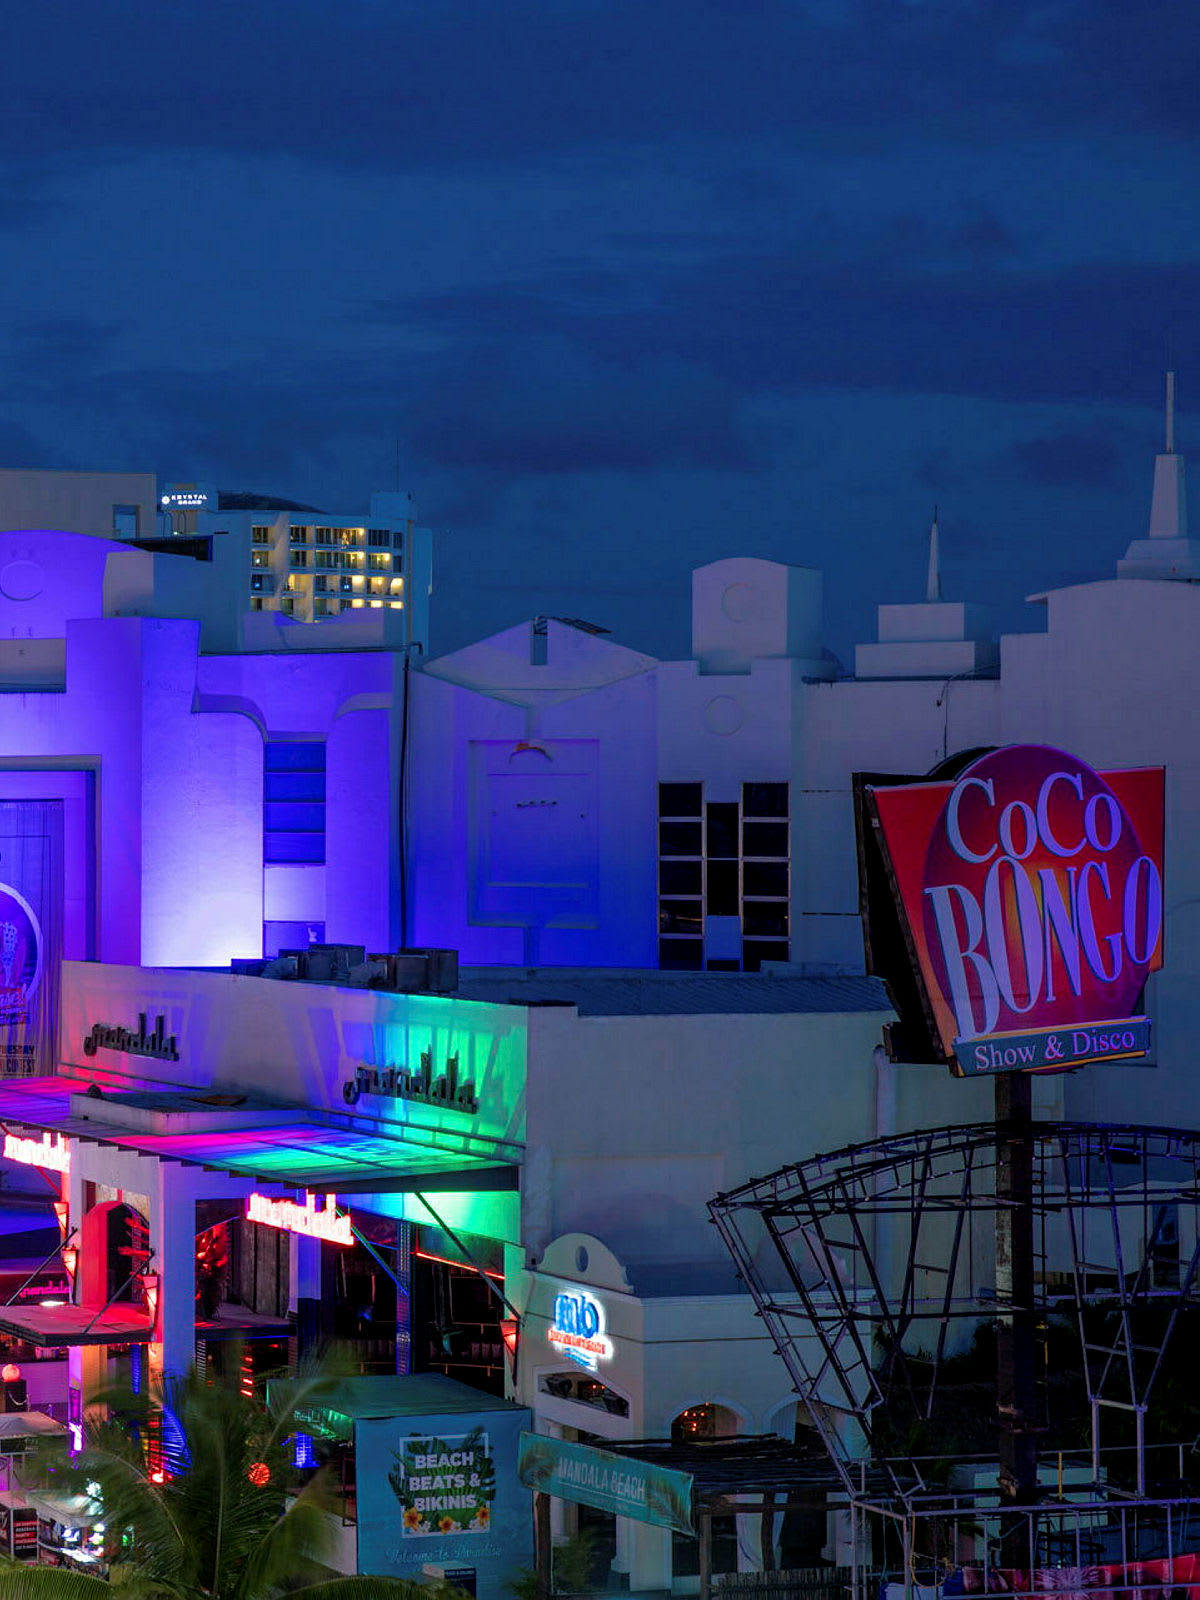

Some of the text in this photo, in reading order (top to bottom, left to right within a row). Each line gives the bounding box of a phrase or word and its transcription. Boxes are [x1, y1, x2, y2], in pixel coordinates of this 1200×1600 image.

[922, 855, 1162, 1044] BONGO
[974, 1028, 1135, 1071] Show & Disco
[415, 1451, 474, 1469] BEACH
[409, 1473, 481, 1491] BEATS &
[558, 1456, 608, 1491] MANDALA
[413, 1494, 478, 1512] BIKINIS
